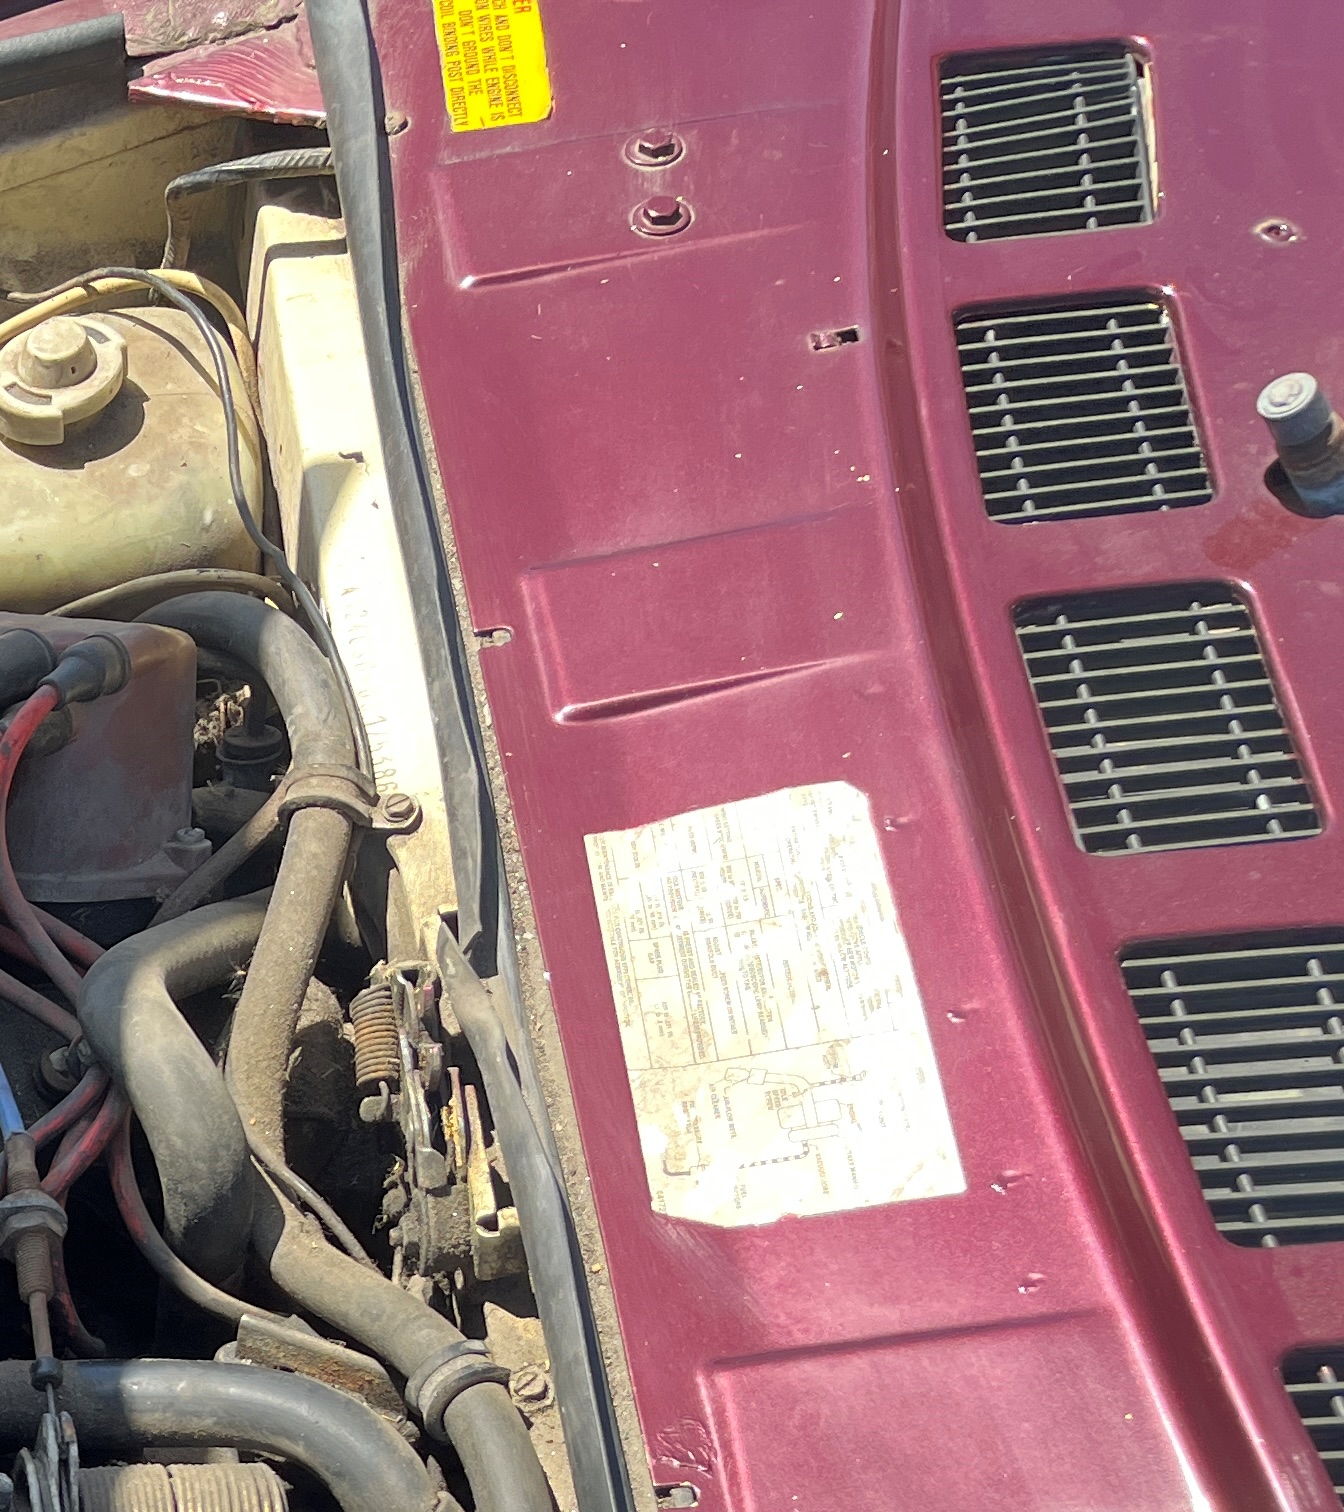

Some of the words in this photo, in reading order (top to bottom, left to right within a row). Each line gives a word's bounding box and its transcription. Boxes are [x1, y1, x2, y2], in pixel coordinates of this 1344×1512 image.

[477, 14, 494, 42] WIRES
[494, 14, 510, 31] AND
[447, 60, 464, 82] POST
[462, 40, 480, 75] GROUND
[481, 46, 499, 74] WHILE
[467, 78, 483, 96] THE
[485, 77, 503, 109] ENGINE
[501, 65, 522, 117] DISCONNECT
[450, 87, 469, 125] DIRECTLY
[490, 112, 505, 122] IS
